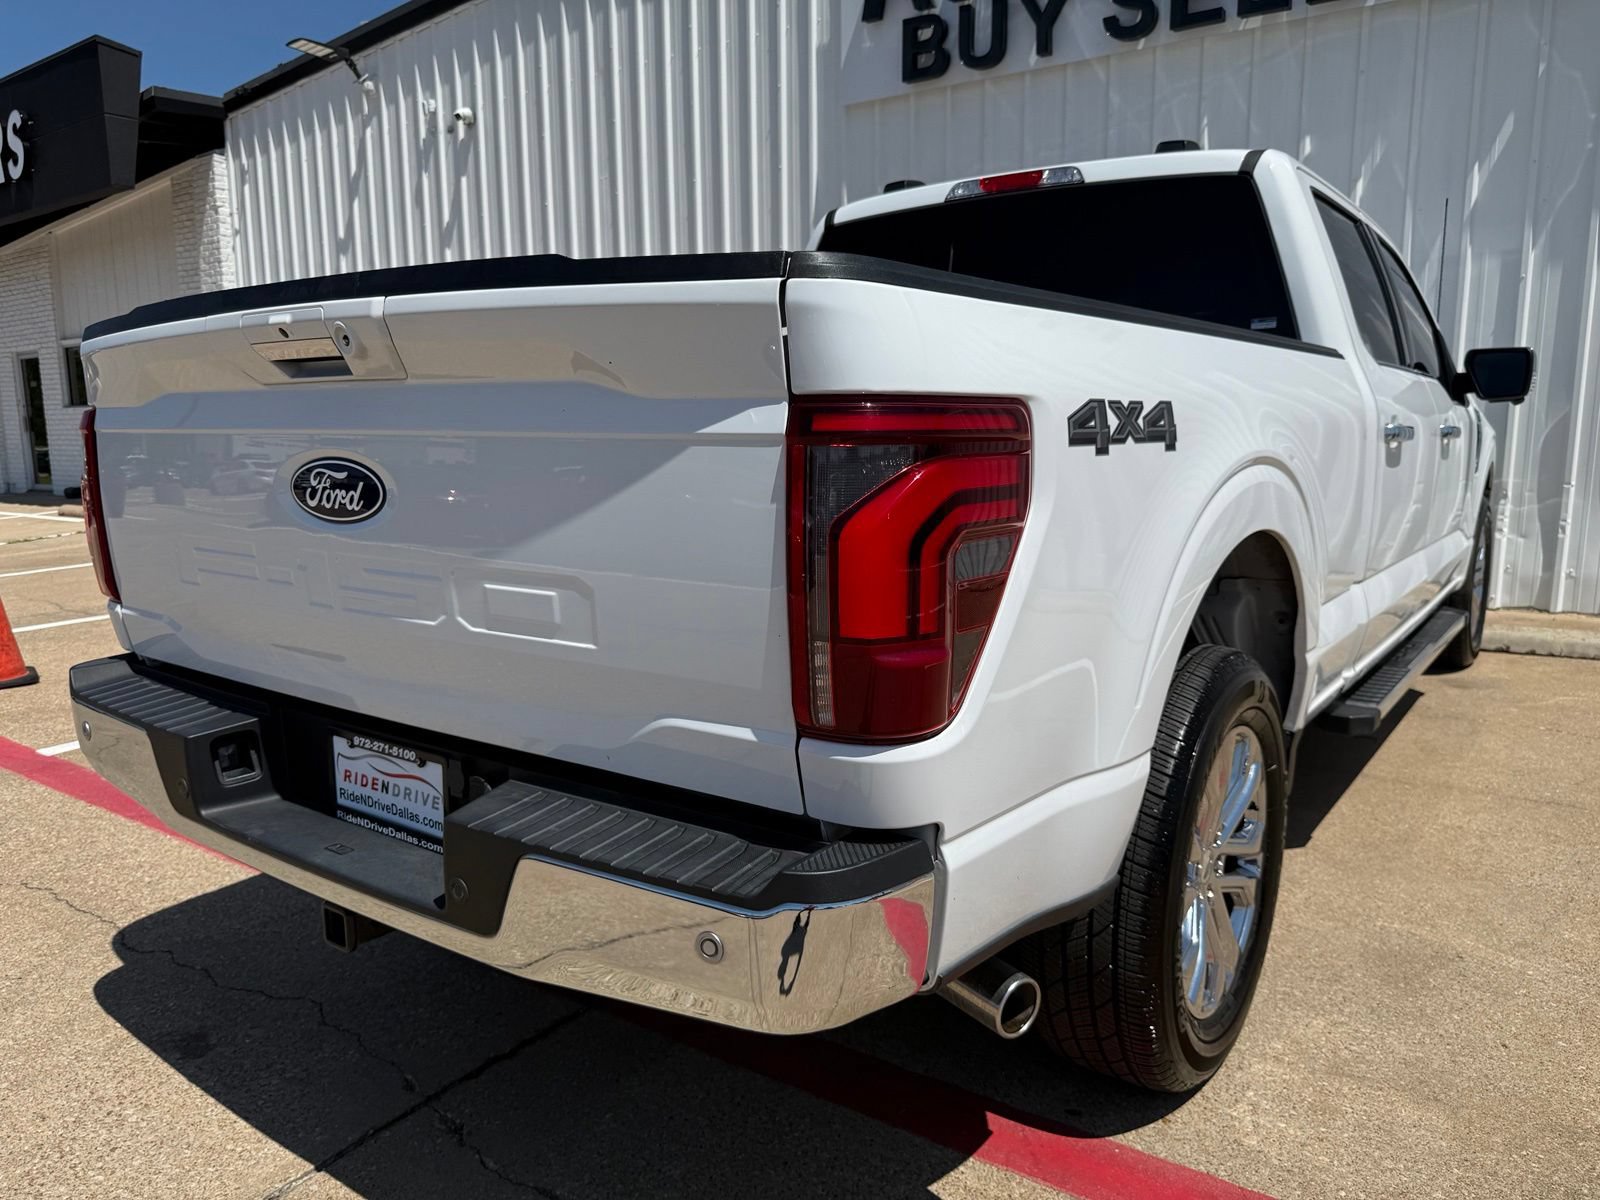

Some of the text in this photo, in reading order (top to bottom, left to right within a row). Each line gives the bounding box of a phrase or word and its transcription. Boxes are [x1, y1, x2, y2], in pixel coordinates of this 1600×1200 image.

[902, 0, 1067, 84] BUY
[305, 467, 365, 512] Ford
[353, 735, 416, 761] 972-271-5100
[339, 787, 444, 832] RideNDriveDallas.com
[343, 769, 441, 811] RIDENDRIVE
[336, 810, 444, 853] RideNDriveDallas.com
